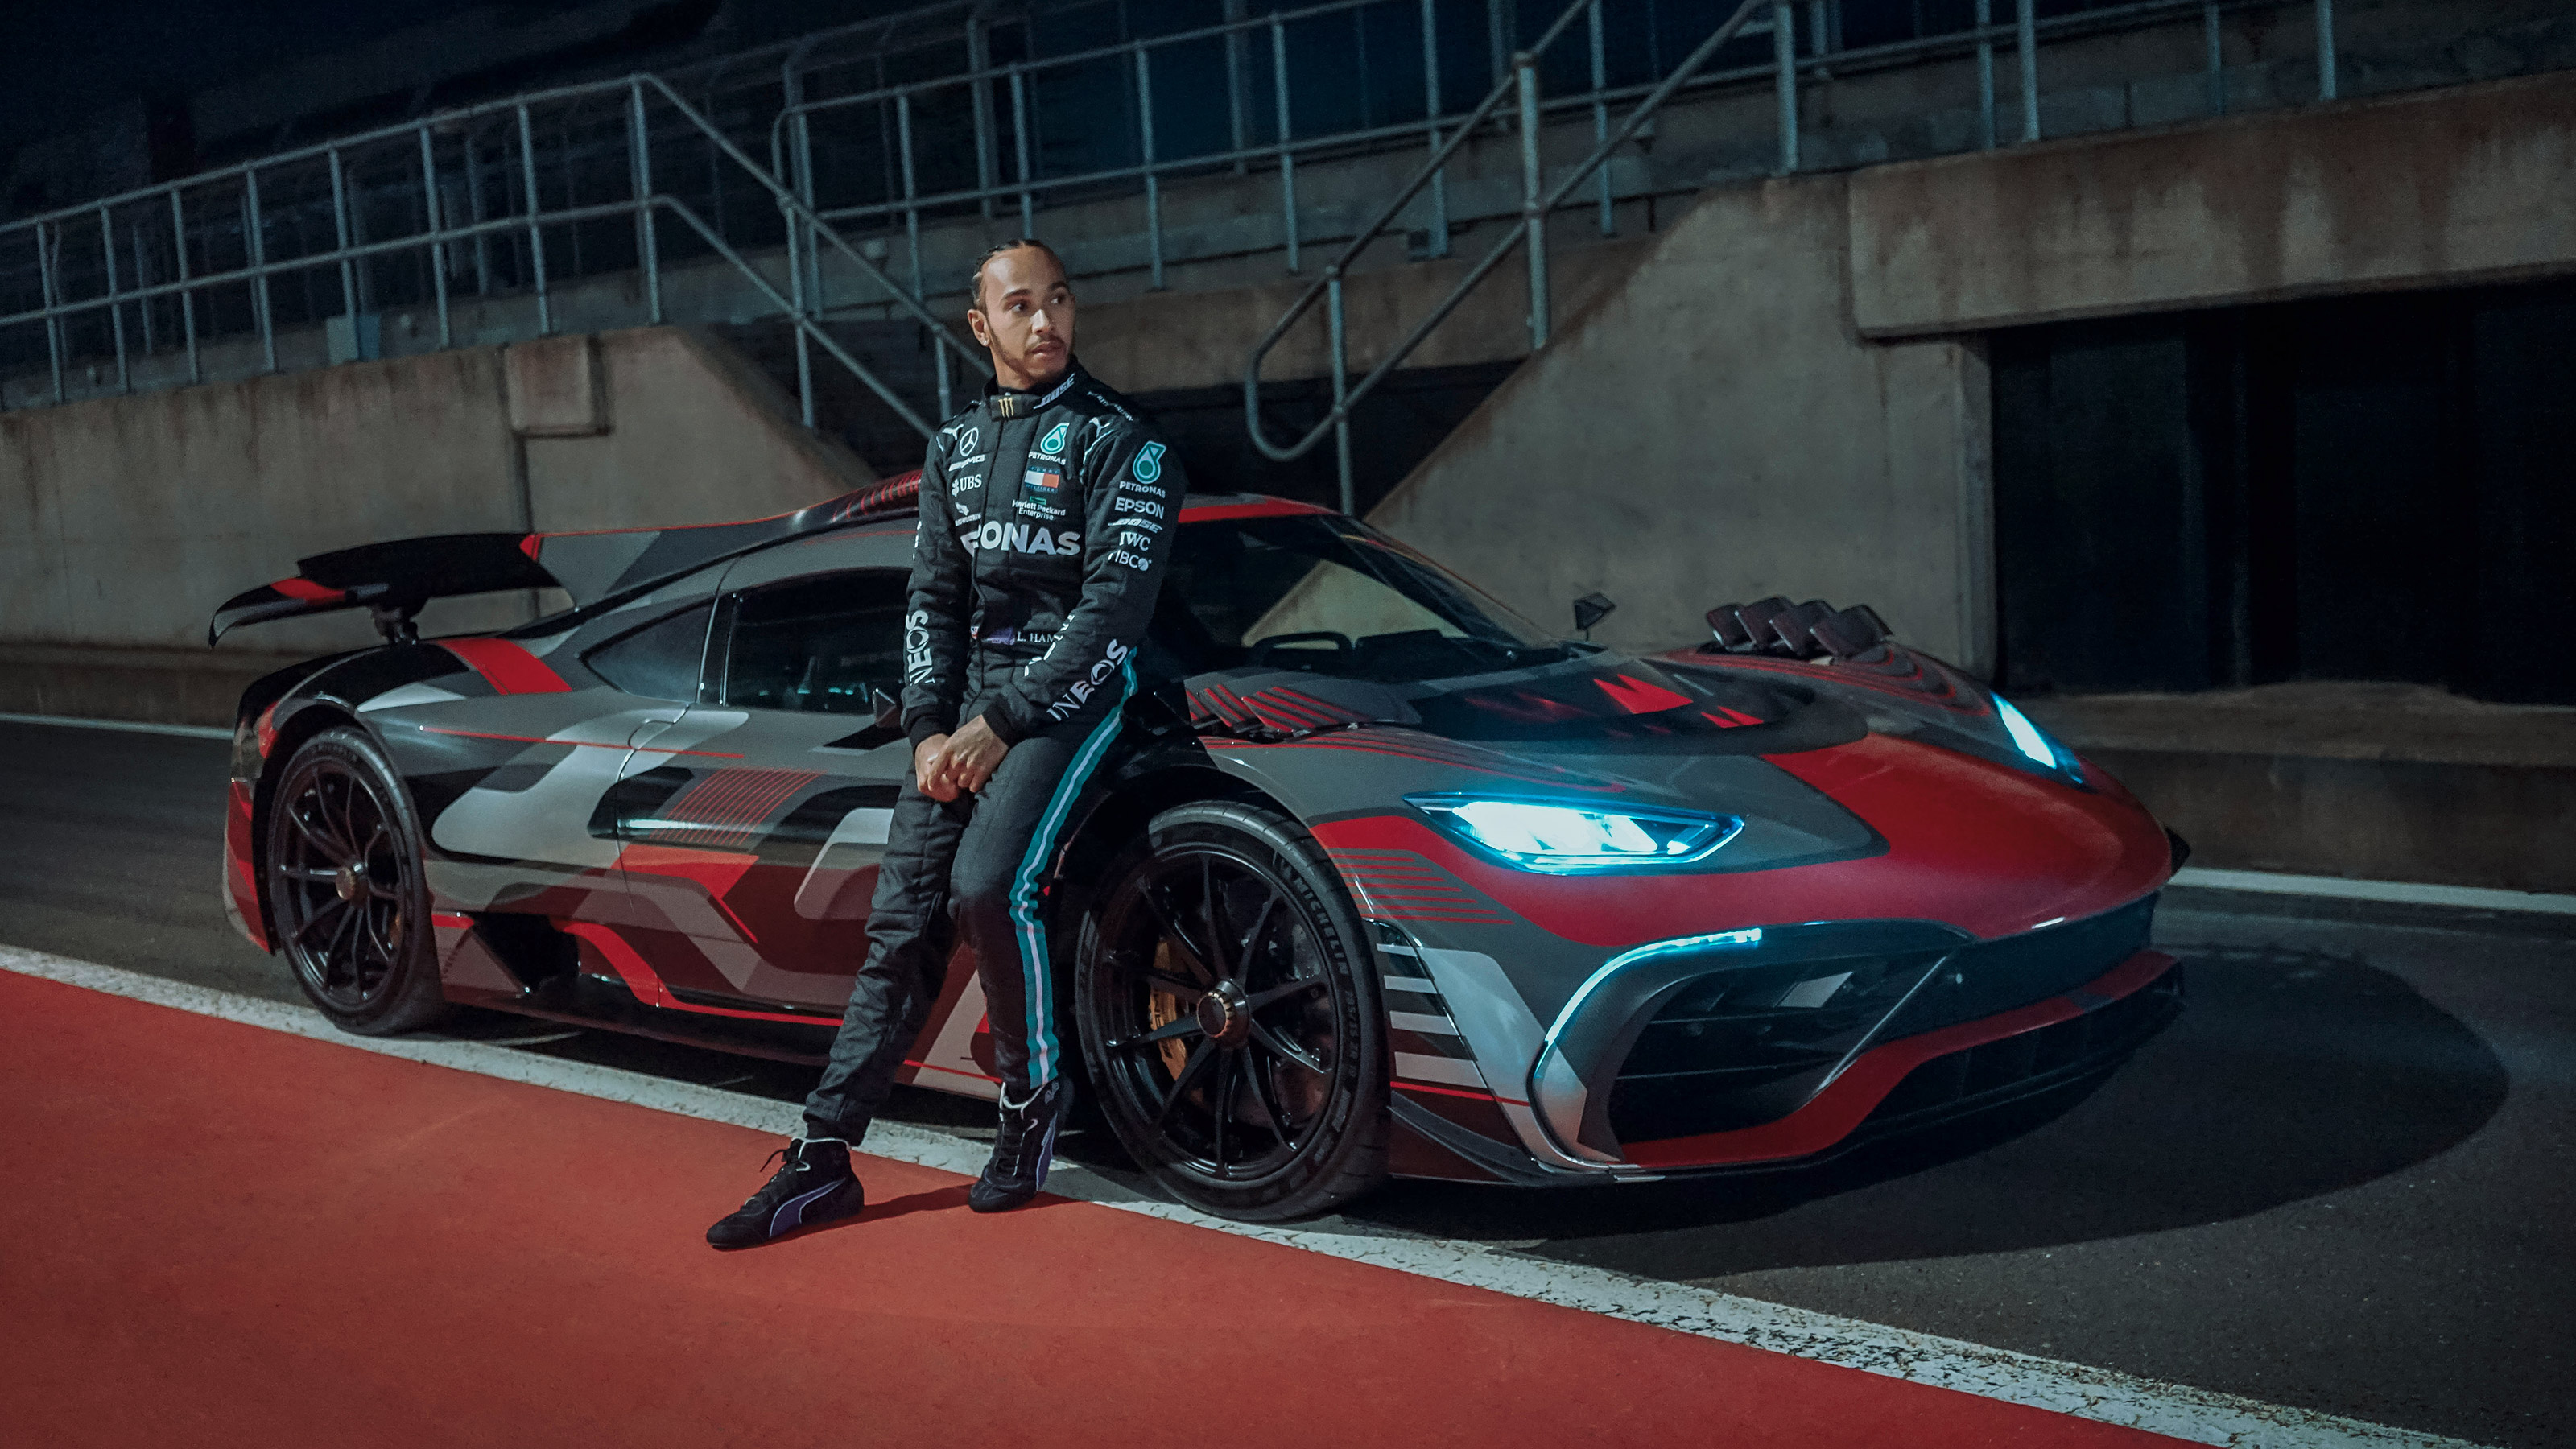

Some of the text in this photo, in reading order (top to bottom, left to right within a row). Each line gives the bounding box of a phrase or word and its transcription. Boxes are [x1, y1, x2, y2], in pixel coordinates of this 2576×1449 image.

[1028, 451, 1067, 465] PETRONAS
[960, 473, 982, 492] UBS
[1119, 481, 1166, 499] PETRONAS
[1012, 499, 1066, 516] Hewlett Packard
[1018, 507, 1055, 521] Enterprise
[1114, 497, 1165, 519] EPSON
[1108, 518, 1163, 533] BOSE
[1119, 531, 1151, 551] IWC
[1017, 631, 1055, 642] L. HAM
[1046, 639, 1128, 721] INEOS
[1292, 876, 1349, 976] MICHELIN
